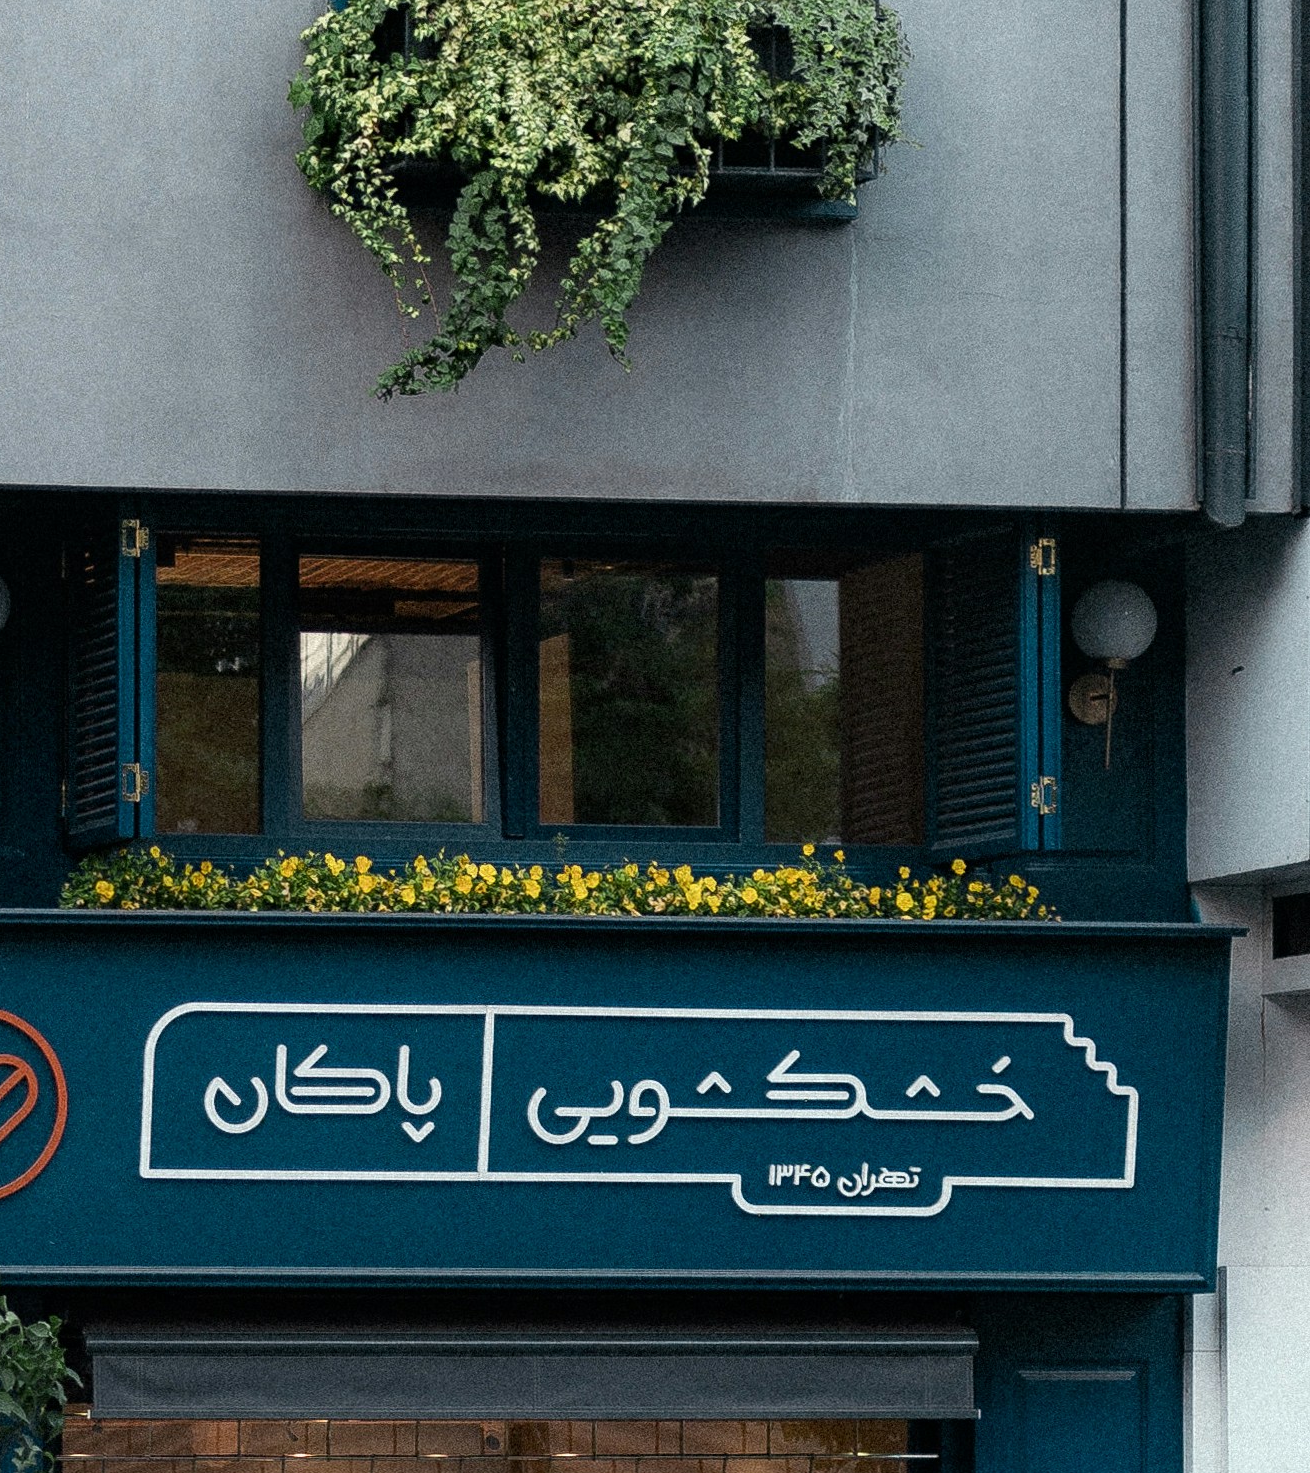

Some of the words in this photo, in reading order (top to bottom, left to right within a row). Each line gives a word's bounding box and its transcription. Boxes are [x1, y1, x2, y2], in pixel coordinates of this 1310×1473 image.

[203, 1044, 443, 1143] پاکان
[527, 1049, 1035, 1145] خشکشویی
[768, 1163, 830, 1188] ۱۳۴۵
[837, 1162, 922, 1197] تهران
